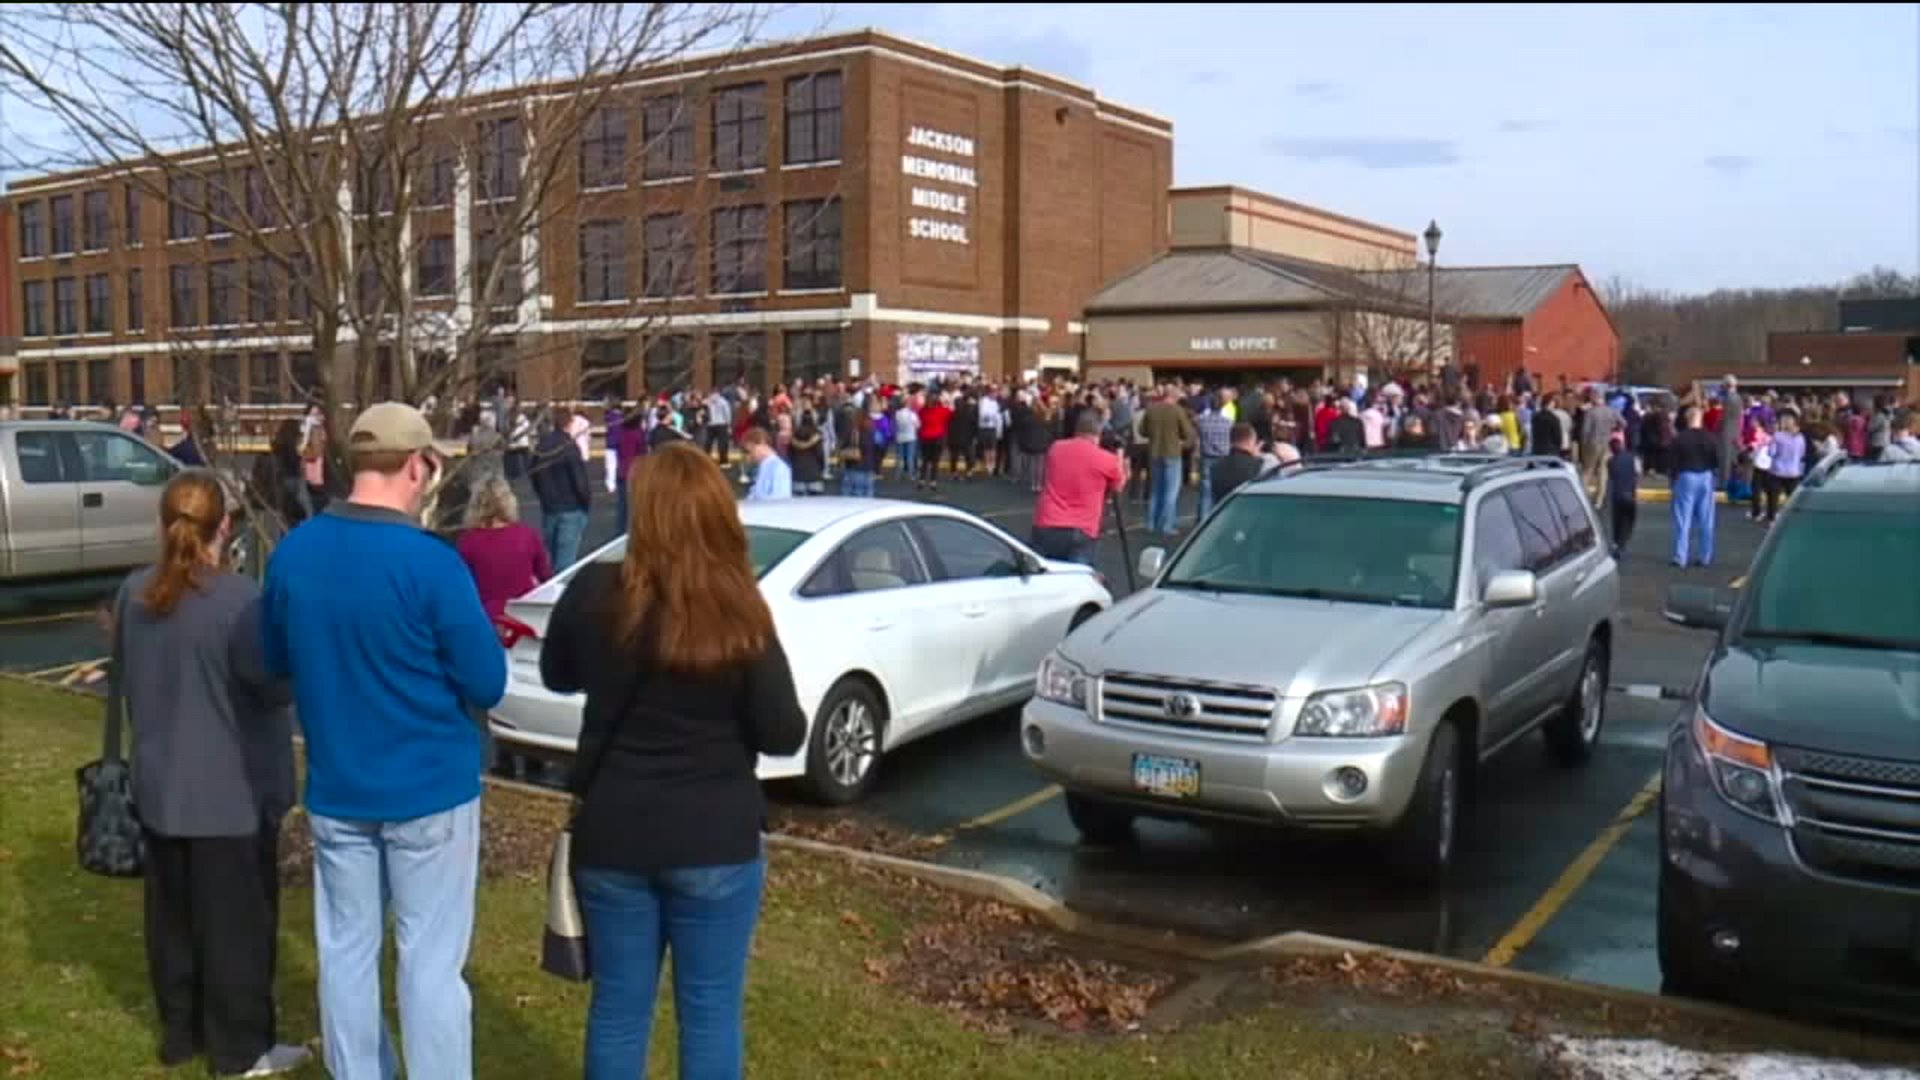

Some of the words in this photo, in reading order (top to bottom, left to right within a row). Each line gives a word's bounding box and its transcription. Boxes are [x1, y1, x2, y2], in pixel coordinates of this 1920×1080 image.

[907, 125, 975, 157] JACKSON
[902, 154, 979, 188] MEMORIAL
[911, 186, 967, 215] MIDDLE
[908, 217, 970, 244] SCHOOL
[1190, 336, 1223, 350] MAIN
[1227, 336, 1277, 351] OFFICE
